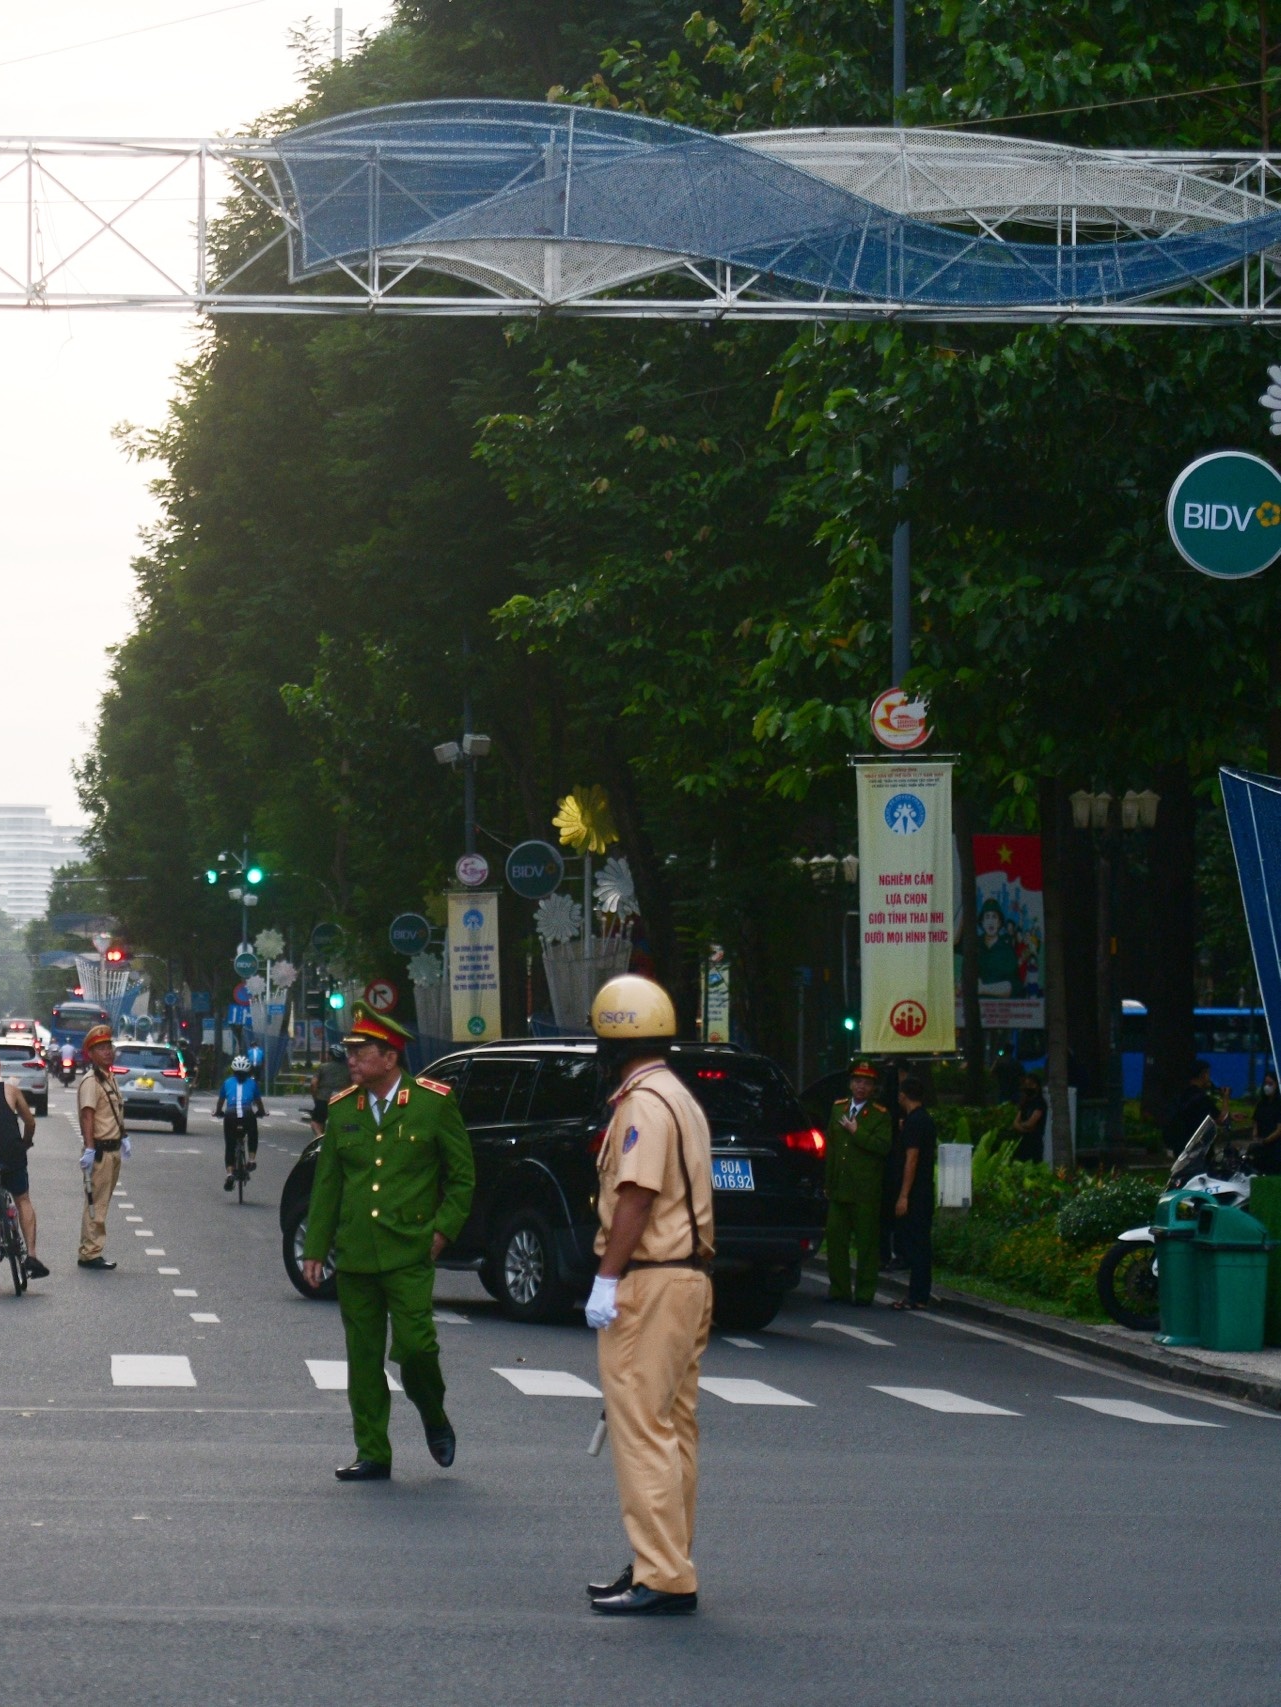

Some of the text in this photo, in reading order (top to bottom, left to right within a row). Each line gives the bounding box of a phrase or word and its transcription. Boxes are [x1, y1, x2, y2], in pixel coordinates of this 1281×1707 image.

[1183, 502, 1256, 532] BIDV
[511, 864, 545, 878] BIDV
[885, 892, 928, 907] LỰA CHỌN
[909, 912, 928, 924] THAI
[930, 912, 944, 924] NHI
[598, 1010, 637, 1024] CSGT
[720, 1160, 742, 1174] 80A
[714, 1174, 752, 1189] 016.92
